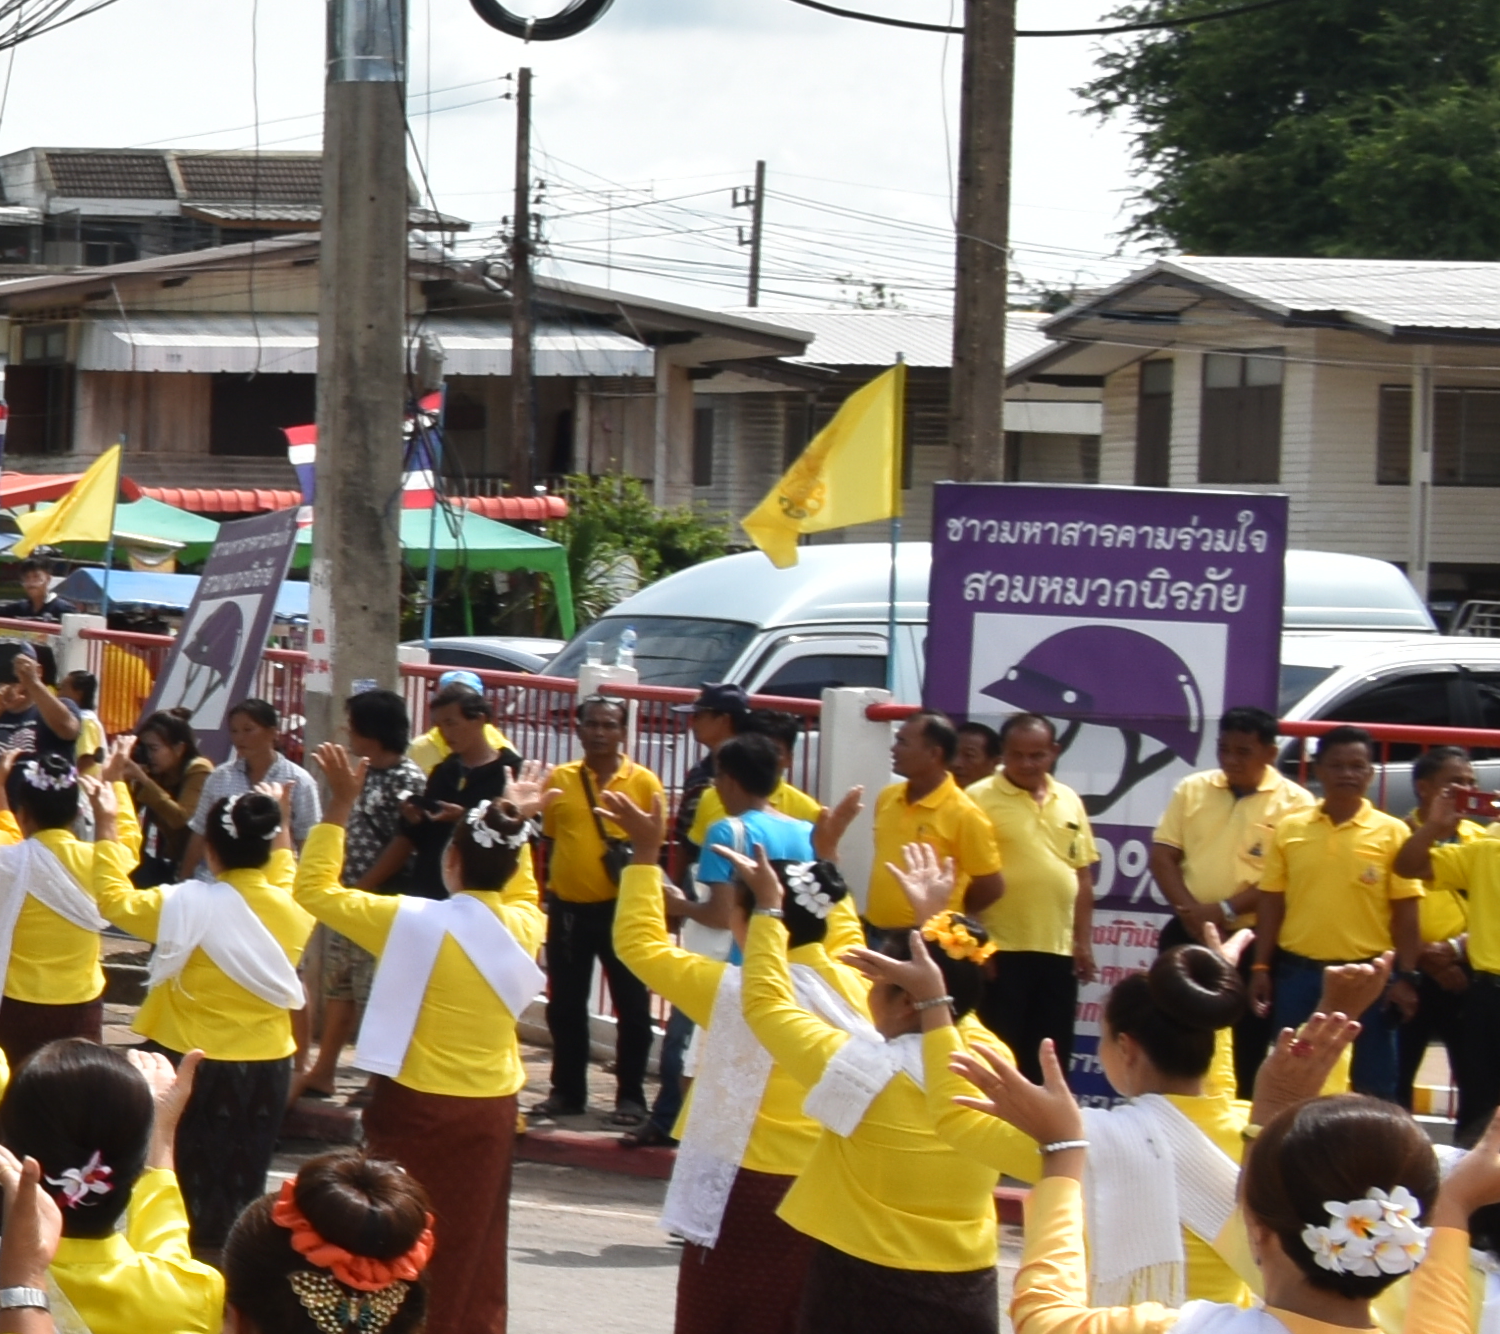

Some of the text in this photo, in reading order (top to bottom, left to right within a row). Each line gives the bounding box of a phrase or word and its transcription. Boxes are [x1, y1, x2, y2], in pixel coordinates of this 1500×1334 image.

[946, 510, 1268, 553] ชาวมหาสารคามร่วมใจ
[963, 567, 1248, 613] สวมหมวกนิรภัย
